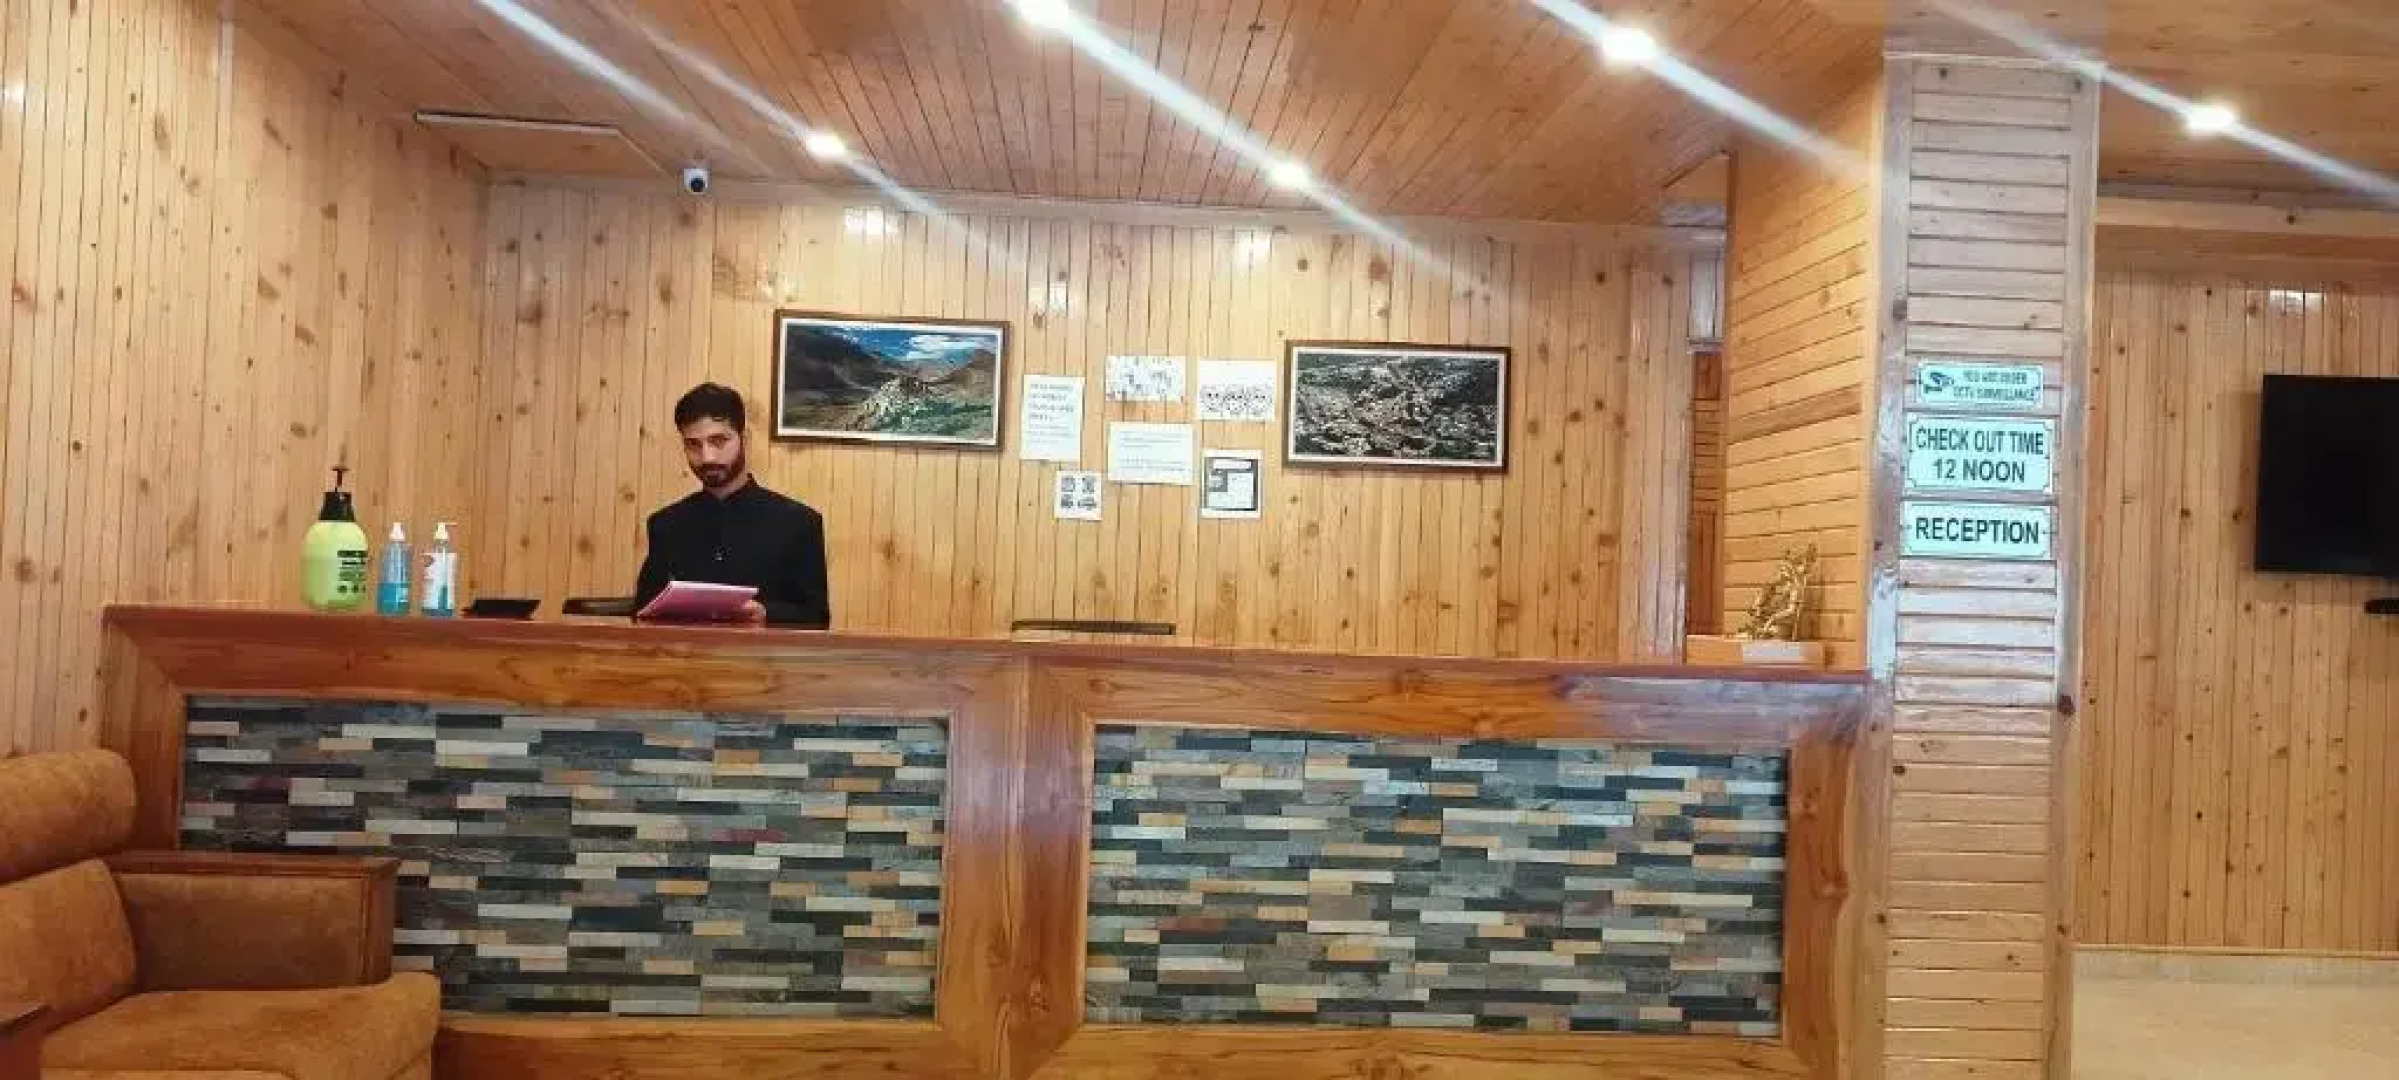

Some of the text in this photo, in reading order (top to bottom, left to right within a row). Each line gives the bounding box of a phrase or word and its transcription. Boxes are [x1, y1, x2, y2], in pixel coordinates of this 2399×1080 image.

[1916, 427, 2043, 455] CHECK OUT TIME
[1933, 458, 2025, 483] 12 NOON
[1915, 517, 2039, 544] RECEPTION
